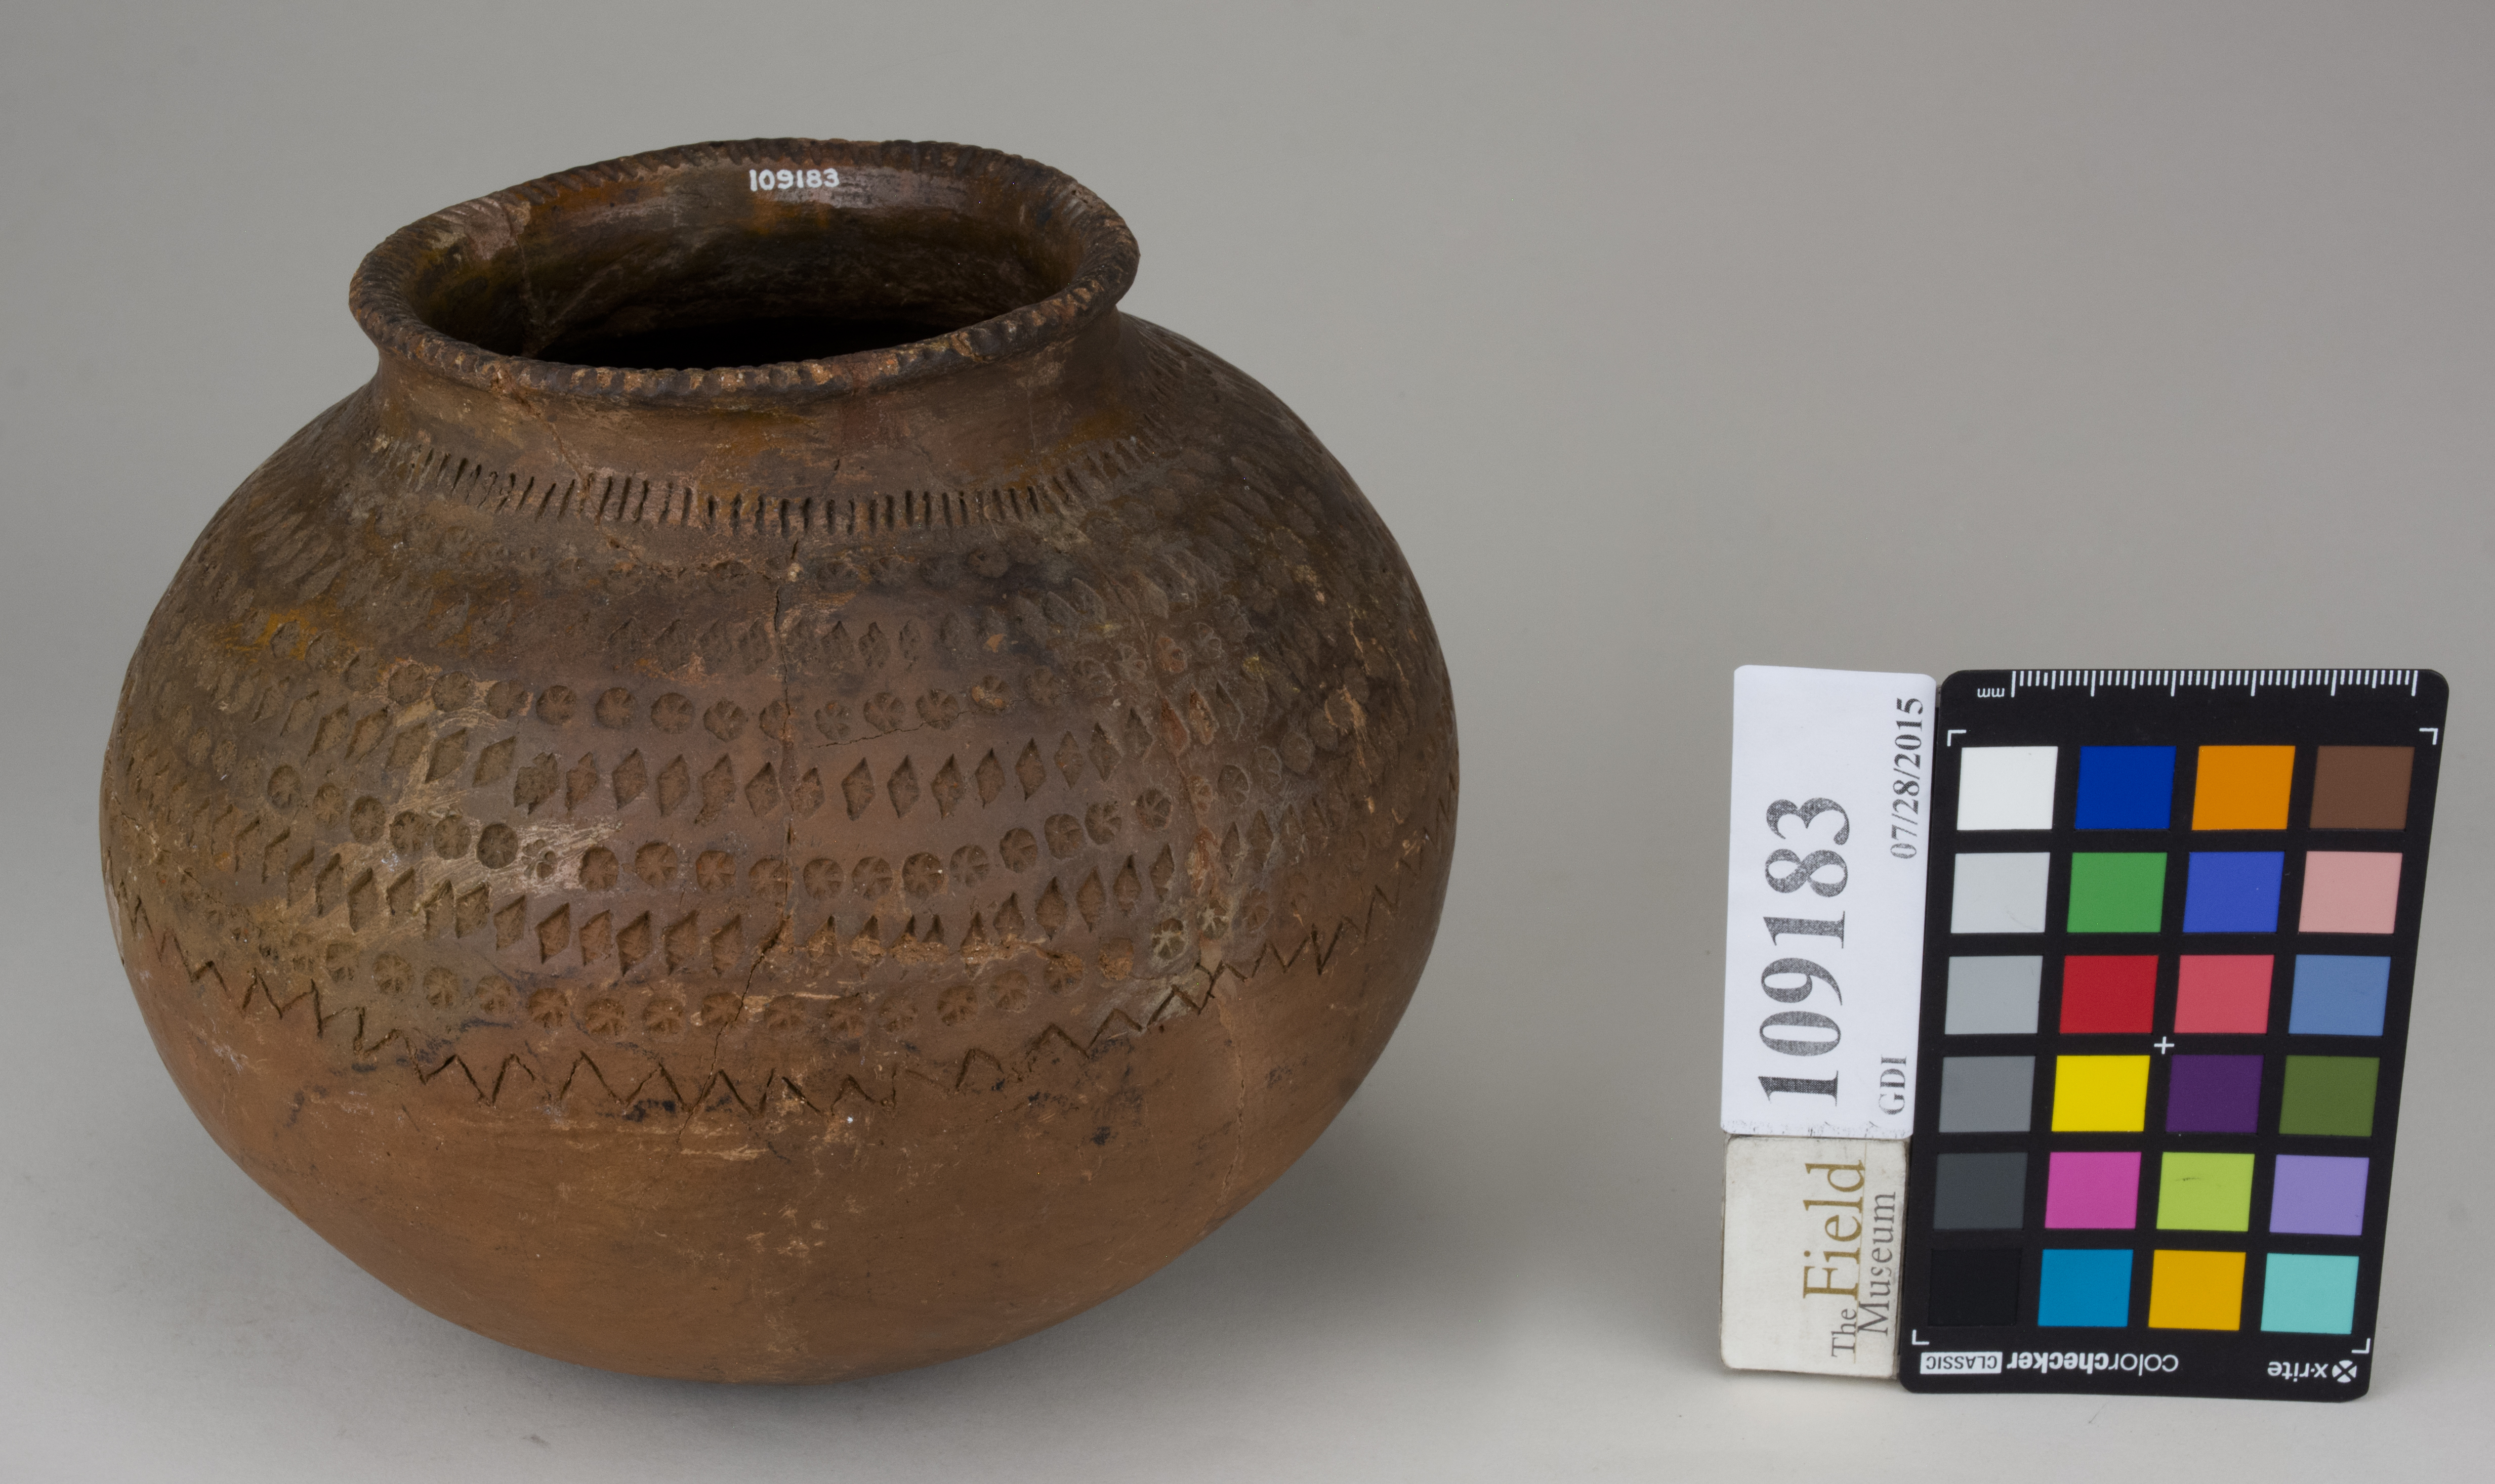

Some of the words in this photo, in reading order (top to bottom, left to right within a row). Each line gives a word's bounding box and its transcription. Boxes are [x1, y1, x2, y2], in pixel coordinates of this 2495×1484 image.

[749, 168, 840, 191] 109183
[1977, 688, 2005, 698] mm
[1890, 698, 1924, 859] 07/28/2015
[1758, 798, 1850, 1107] 109183
[1879, 1056, 1907, 1115] GDI
[1803, 1160, 1865, 1300] Field
[1858, 1192, 1896, 1337] Museum
[1831, 1308, 1857, 1357] The
[1926, 1356, 1997, 1369] CLASSIC
[2007, 1352, 2179, 1376] colorchecker
